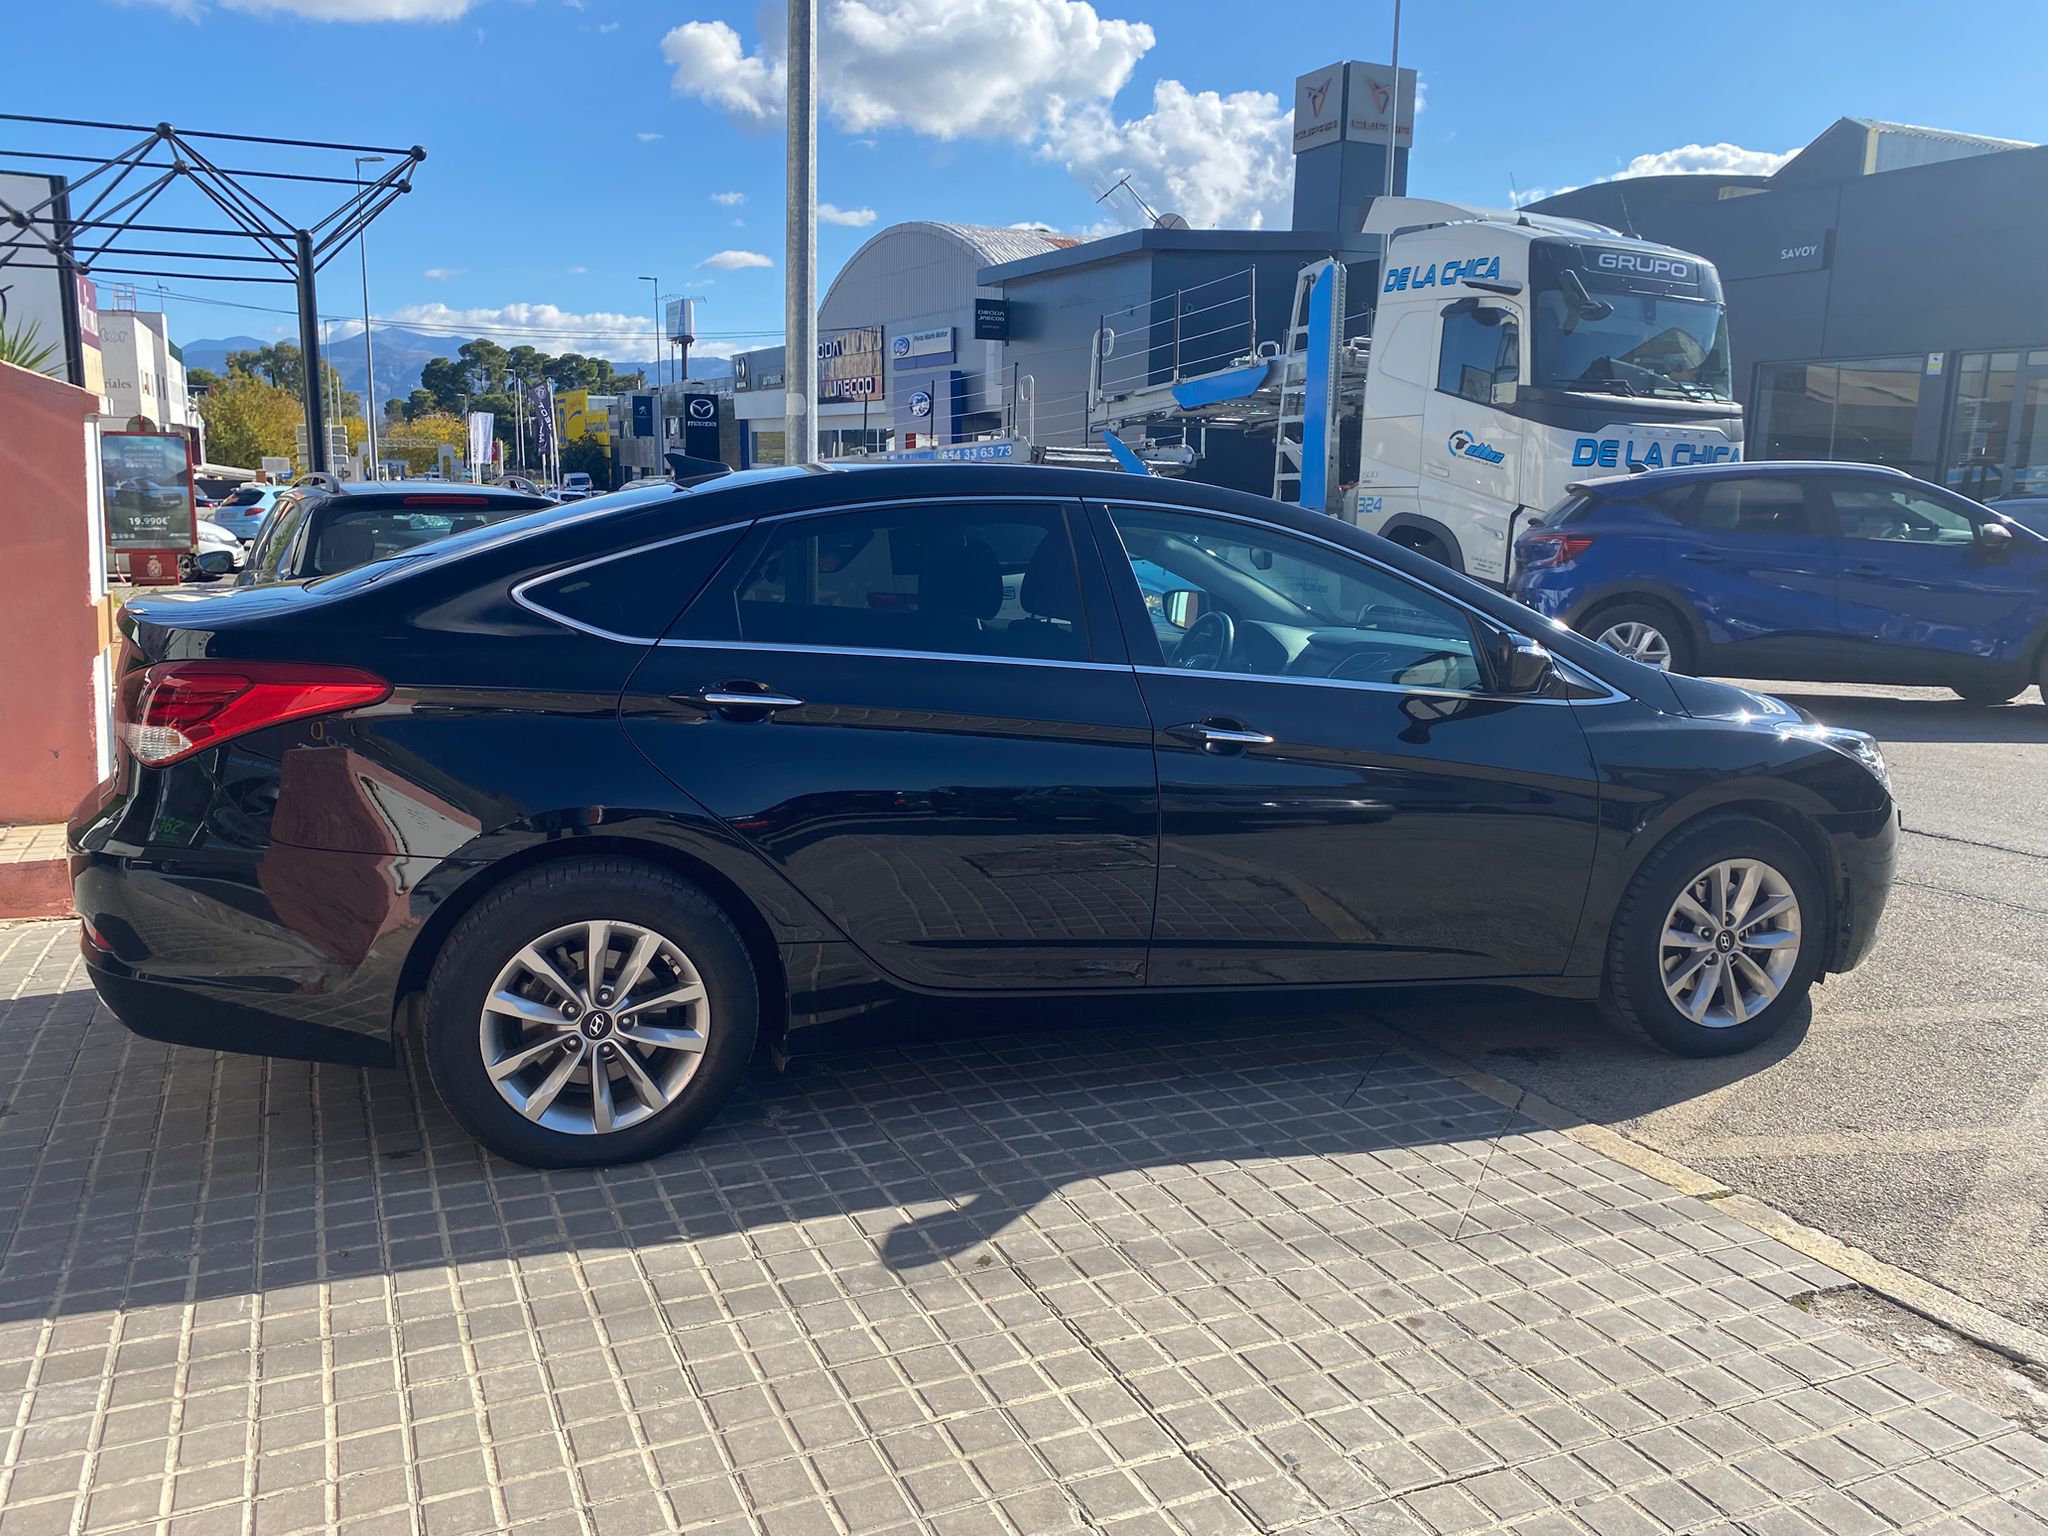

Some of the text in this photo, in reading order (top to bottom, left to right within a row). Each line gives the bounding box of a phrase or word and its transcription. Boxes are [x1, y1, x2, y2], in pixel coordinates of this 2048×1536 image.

[1781, 245, 1818, 259] SAVOY
[1383, 256, 1500, 292] DE LA CHICA
[1598, 253, 1687, 278] GRUPO
[817, 340, 845, 359] ODA
[830, 377, 872, 397] JAECOO
[964, 449, 977, 459] 33
[980, 447, 994, 458] 63
[998, 445, 1012, 456] 73
[1572, 438, 1620, 467] DE
[1625, 441, 1664, 468] LA
[1358, 496, 1383, 513] 324
